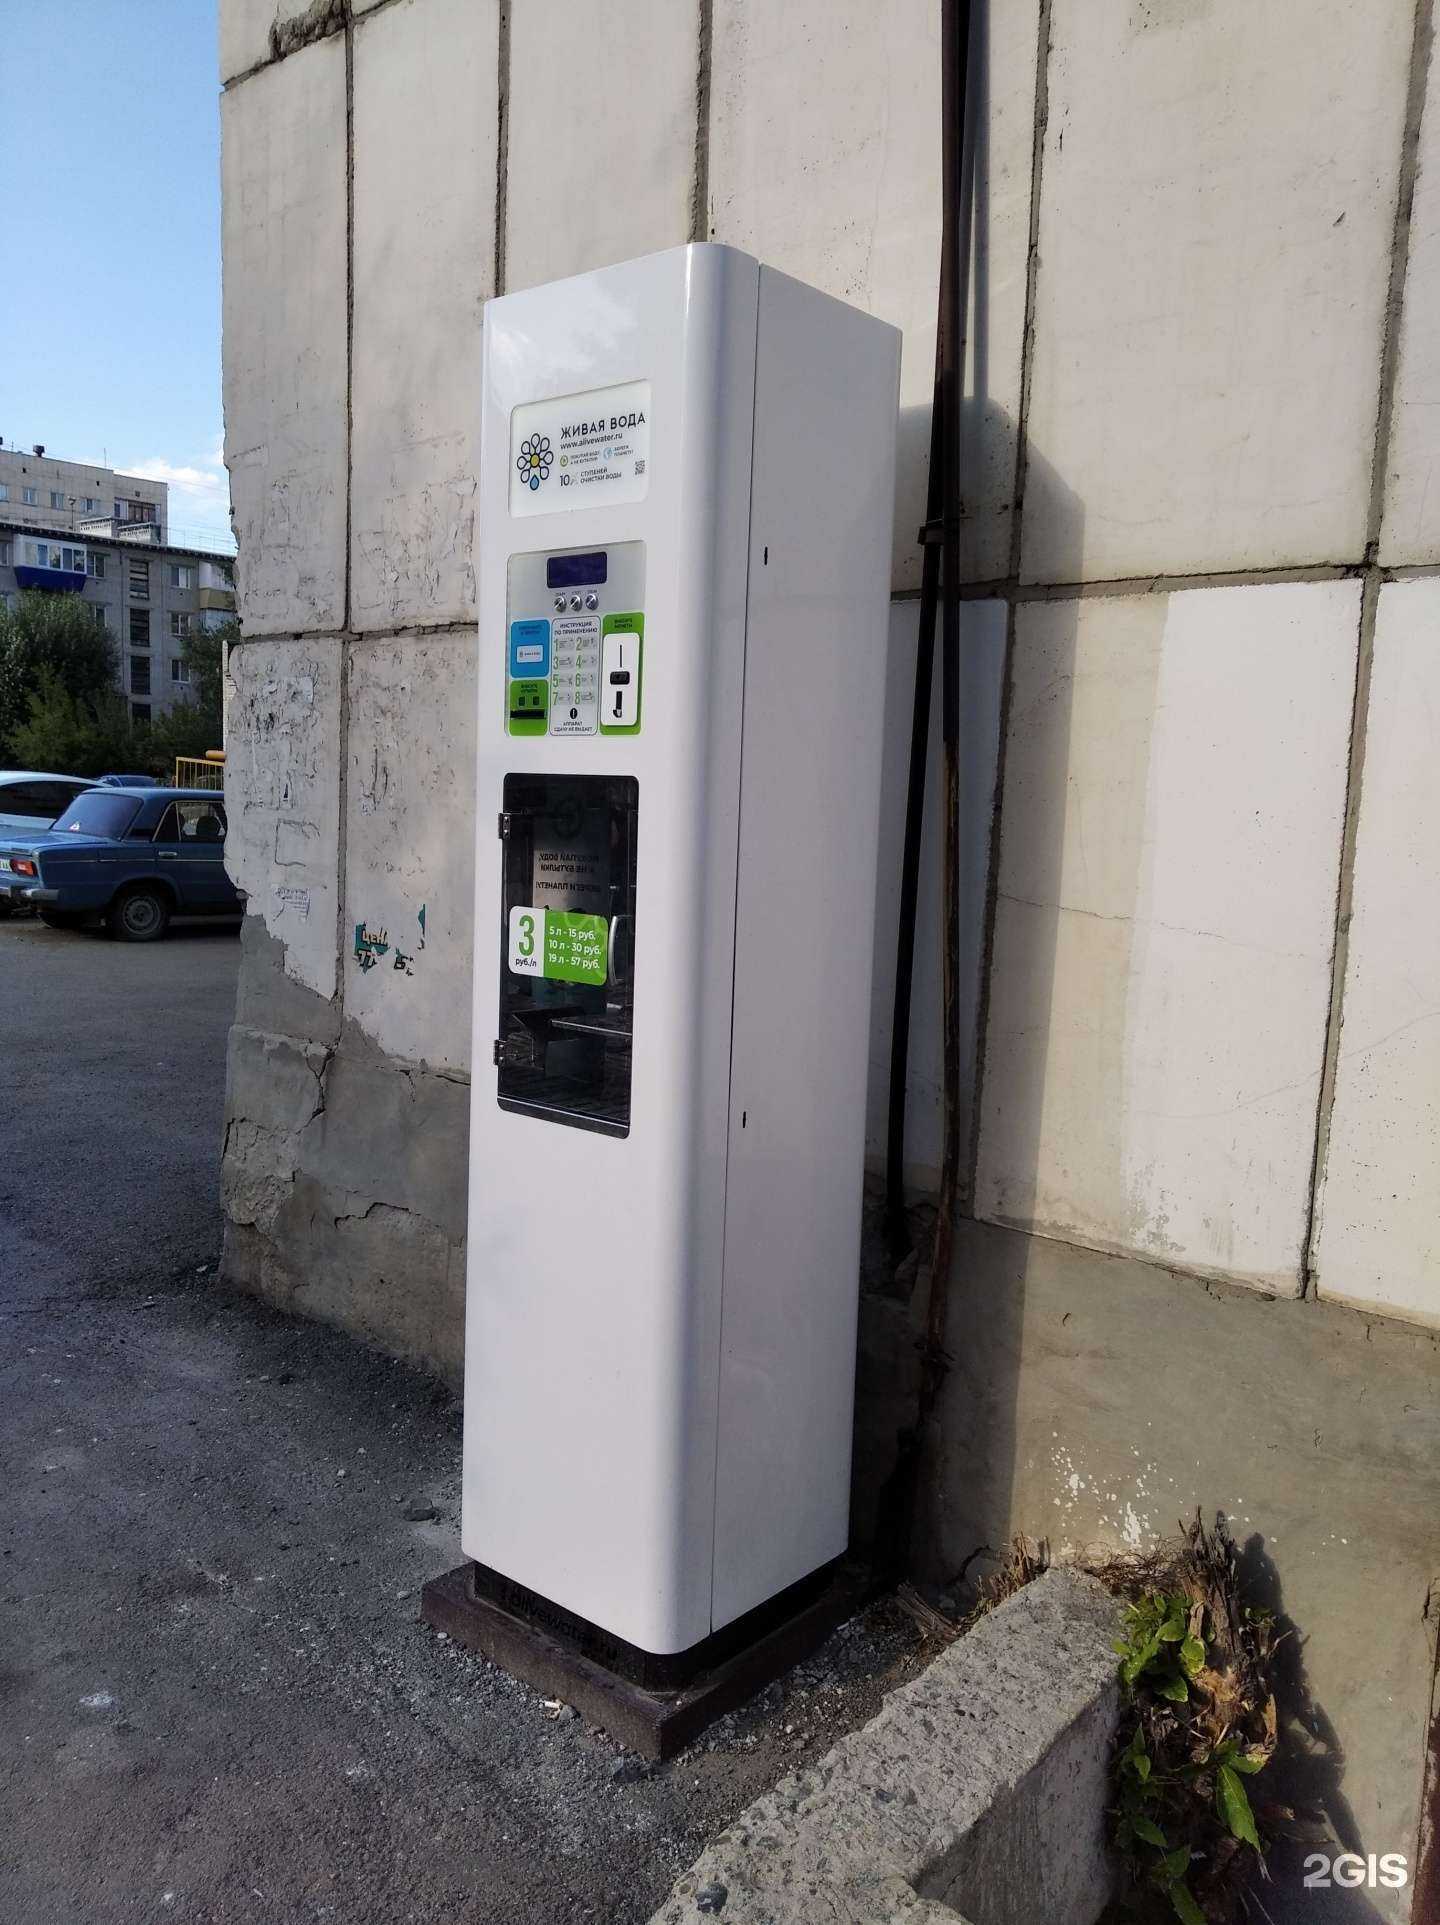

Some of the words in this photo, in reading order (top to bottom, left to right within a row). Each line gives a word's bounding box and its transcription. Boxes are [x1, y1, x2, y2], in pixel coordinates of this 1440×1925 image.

[561, 420, 605, 439] ЖИВАЯ
[610, 412, 646, 429] ВОДА
[560, 433, 623, 449] www.alivewater.ru
[560, 475, 570, 486] 10
[553, 639, 558, 652] 1
[576, 637, 582, 651] 2
[553, 656, 559, 670] 3
[576, 655, 581, 668] 4
[552, 674, 559, 687] 5
[575, 673, 581, 687] 6
[552, 691, 558, 705] 7
[575, 691, 581, 704] 8
[518, 915, 535, 956] 3
[549, 926, 555, 935] 5
[568, 928, 577, 937] 15
[578, 930, 596, 941] руб.
[549, 940, 558, 949] 10
[572, 943, 582, 952] 30
[584, 945, 601, 955] руб.
[515, 958, 537, 967] руб./л
[548, 954, 557, 963] 19
[558, 956, 564, 964] л
[571, 957, 581, 966] 57
[582, 959, 600, 969] руб.
